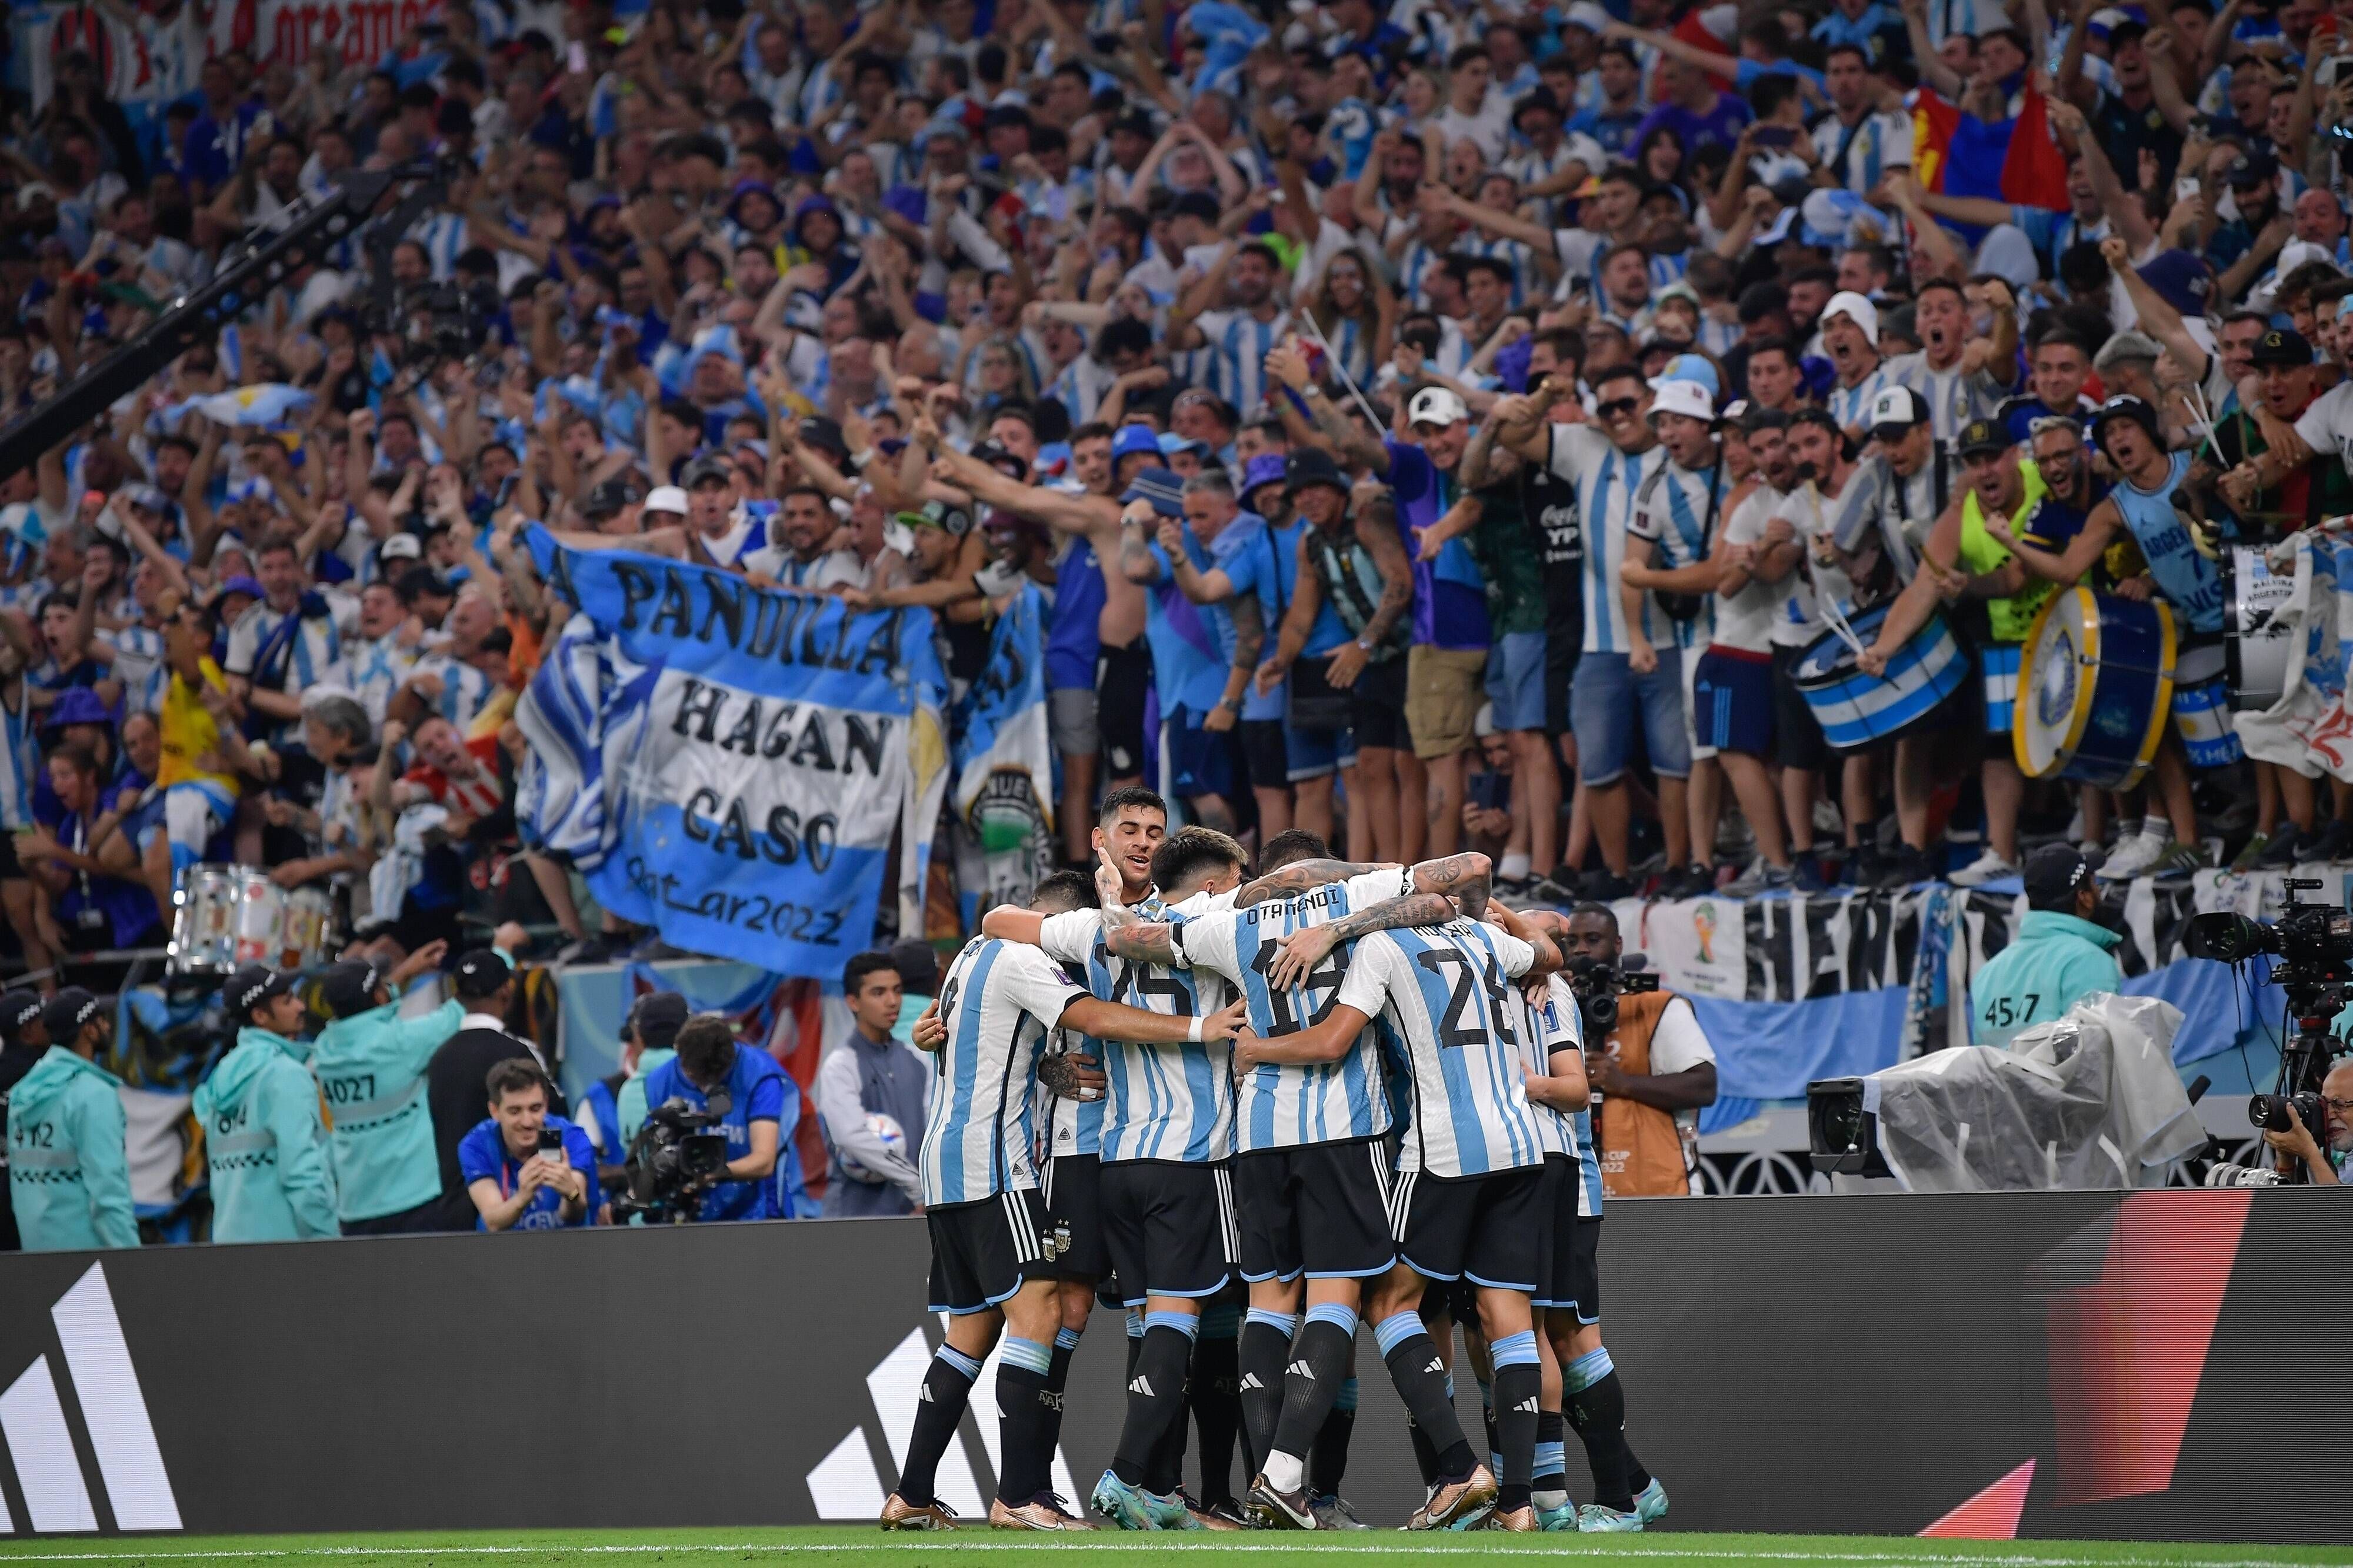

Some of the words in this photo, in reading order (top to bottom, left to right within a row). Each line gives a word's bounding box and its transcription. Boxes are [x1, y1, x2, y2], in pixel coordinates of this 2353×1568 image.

[2144, 527, 2190, 561] ARGEN
[612, 560, 907, 678] PANDILLA
[2184, 579, 2224, 613] VIS
[671, 679, 894, 779] HAGAN
[682, 788, 840, 874] CASO
[1246, 888, 1339, 926] OTAMENDI
